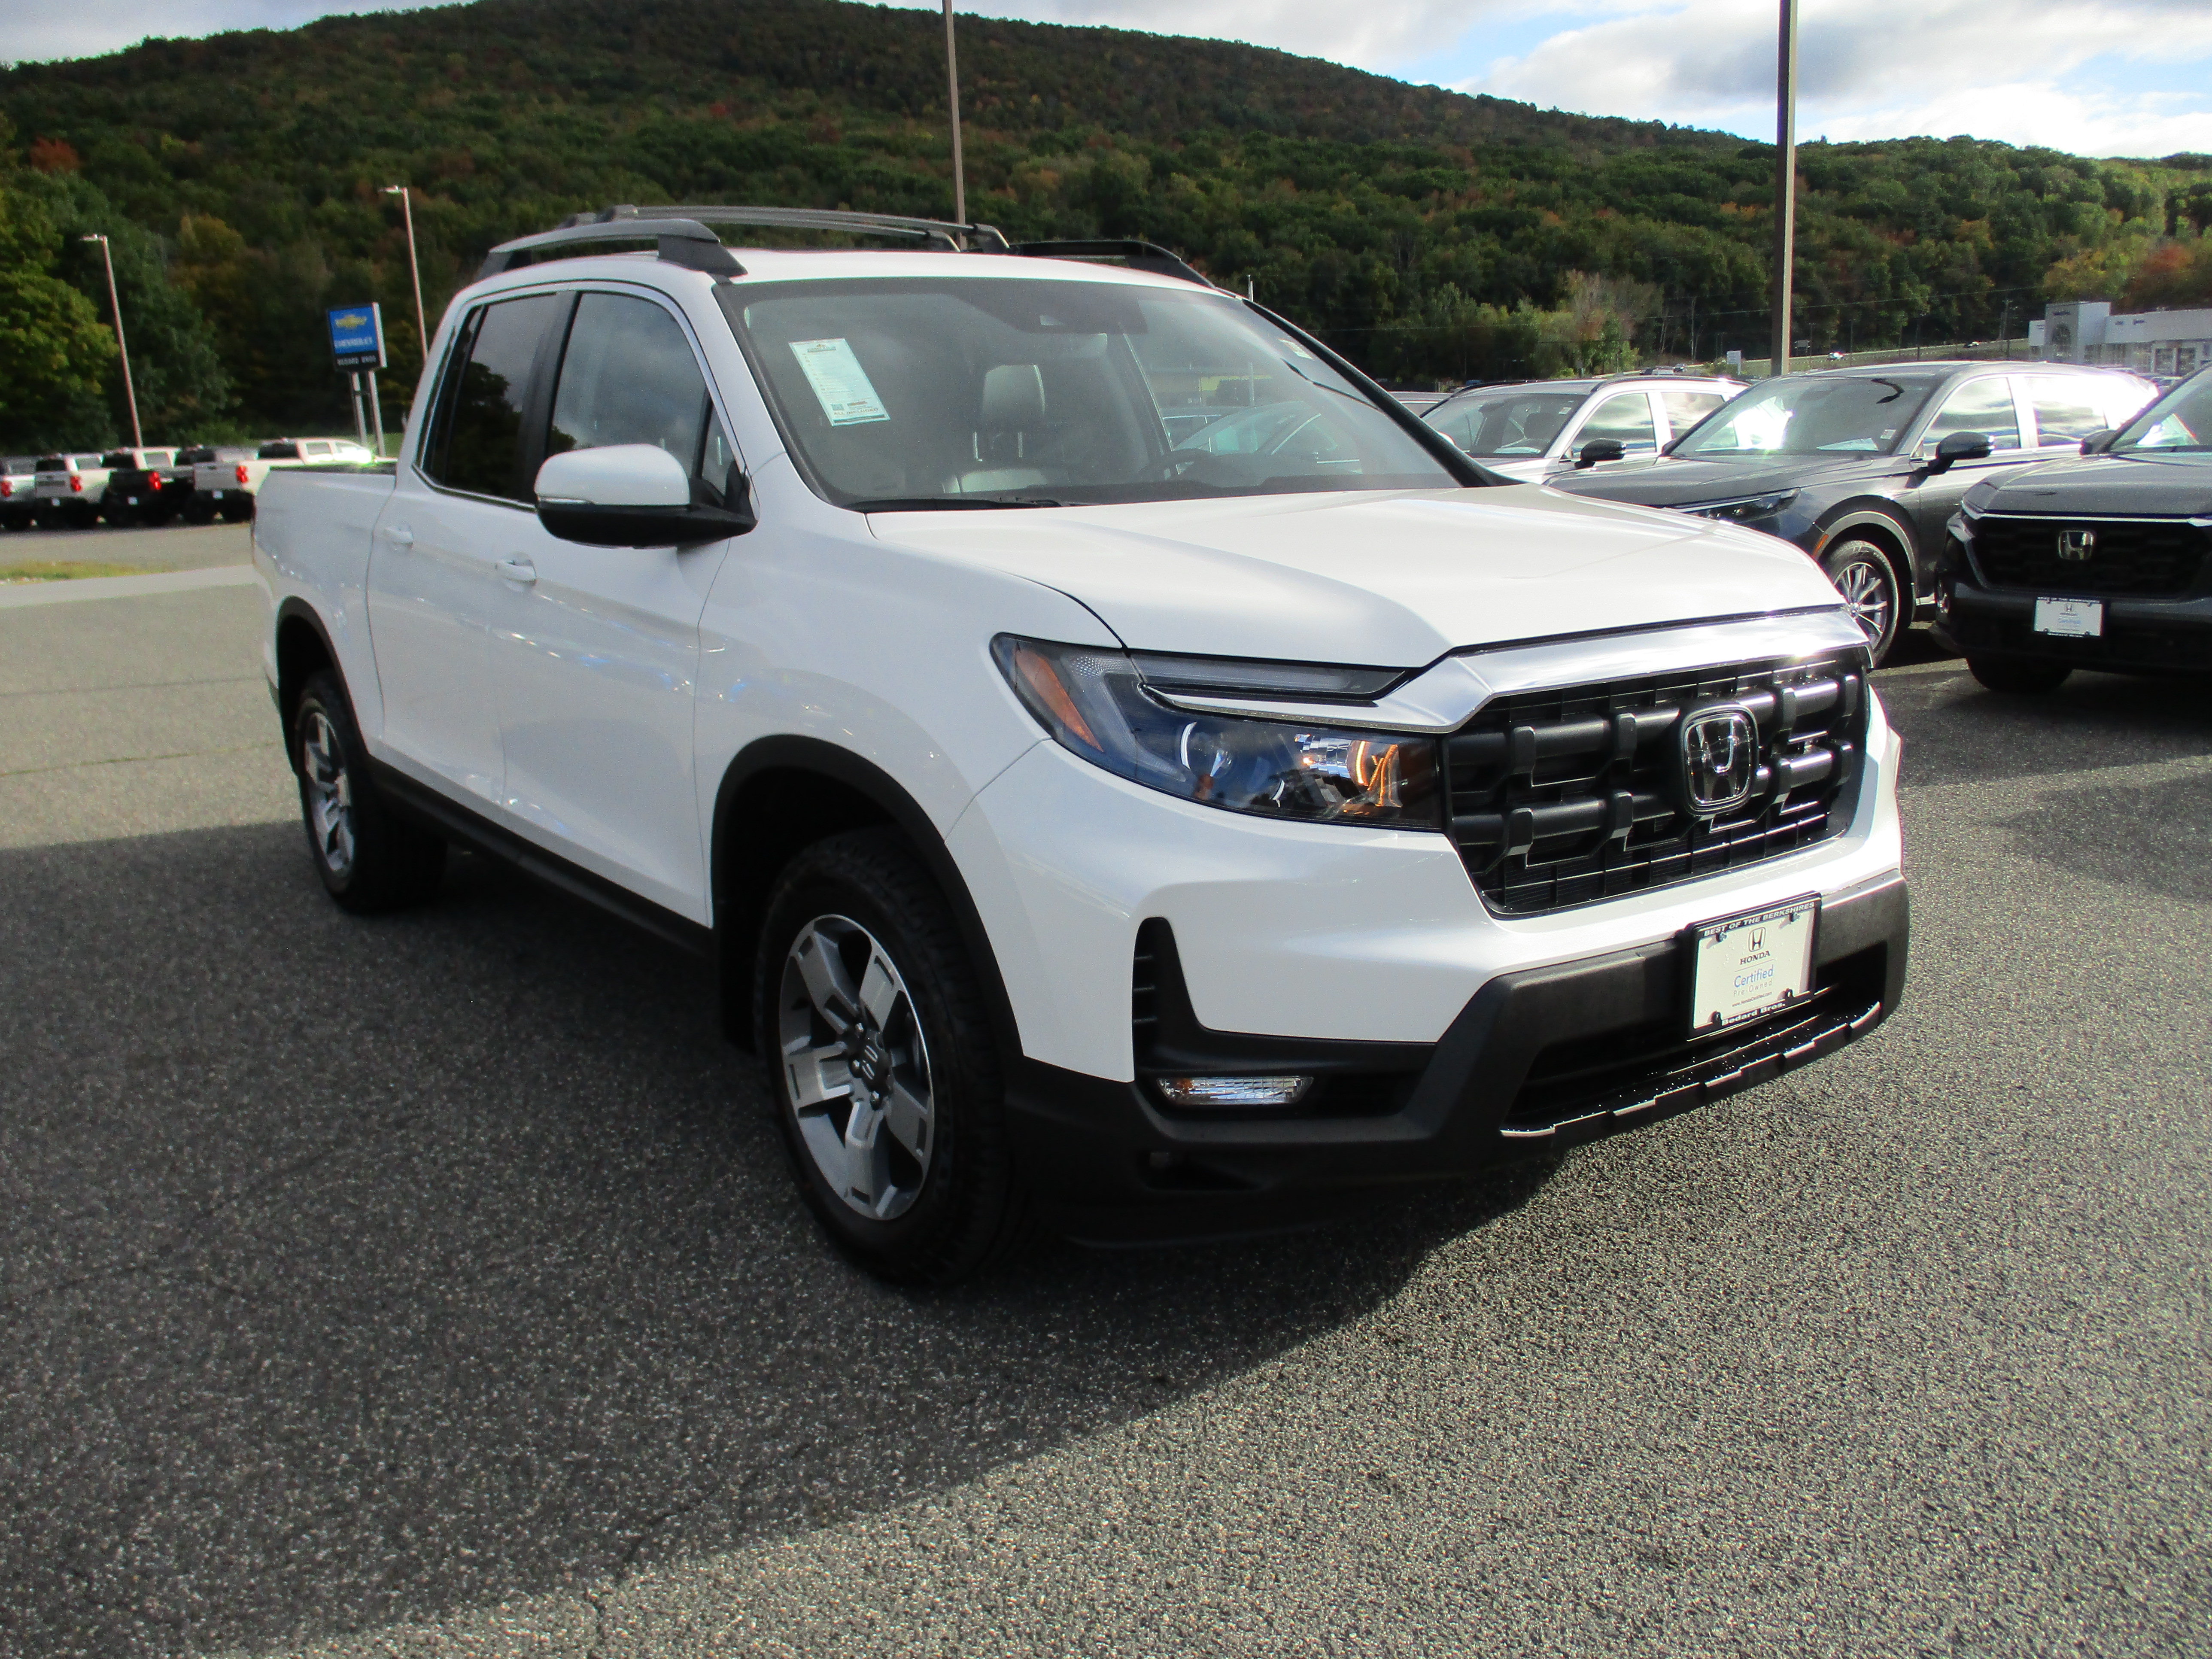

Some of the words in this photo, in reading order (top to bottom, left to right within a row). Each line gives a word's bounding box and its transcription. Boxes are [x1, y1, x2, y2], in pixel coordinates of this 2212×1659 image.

[1704, 925, 1728, 937] BEST
[1743, 917, 1761, 925] THE
[1762, 902, 1815, 921] BERKSHIRES
[1740, 951, 1771, 965] HONDA
[1734, 964, 1774, 988] Certified
[1733, 979, 1772, 997] Pre-Owned
[1721, 1010, 1758, 1026] Bedard
[1760, 1003, 1786, 1014] Bros.
